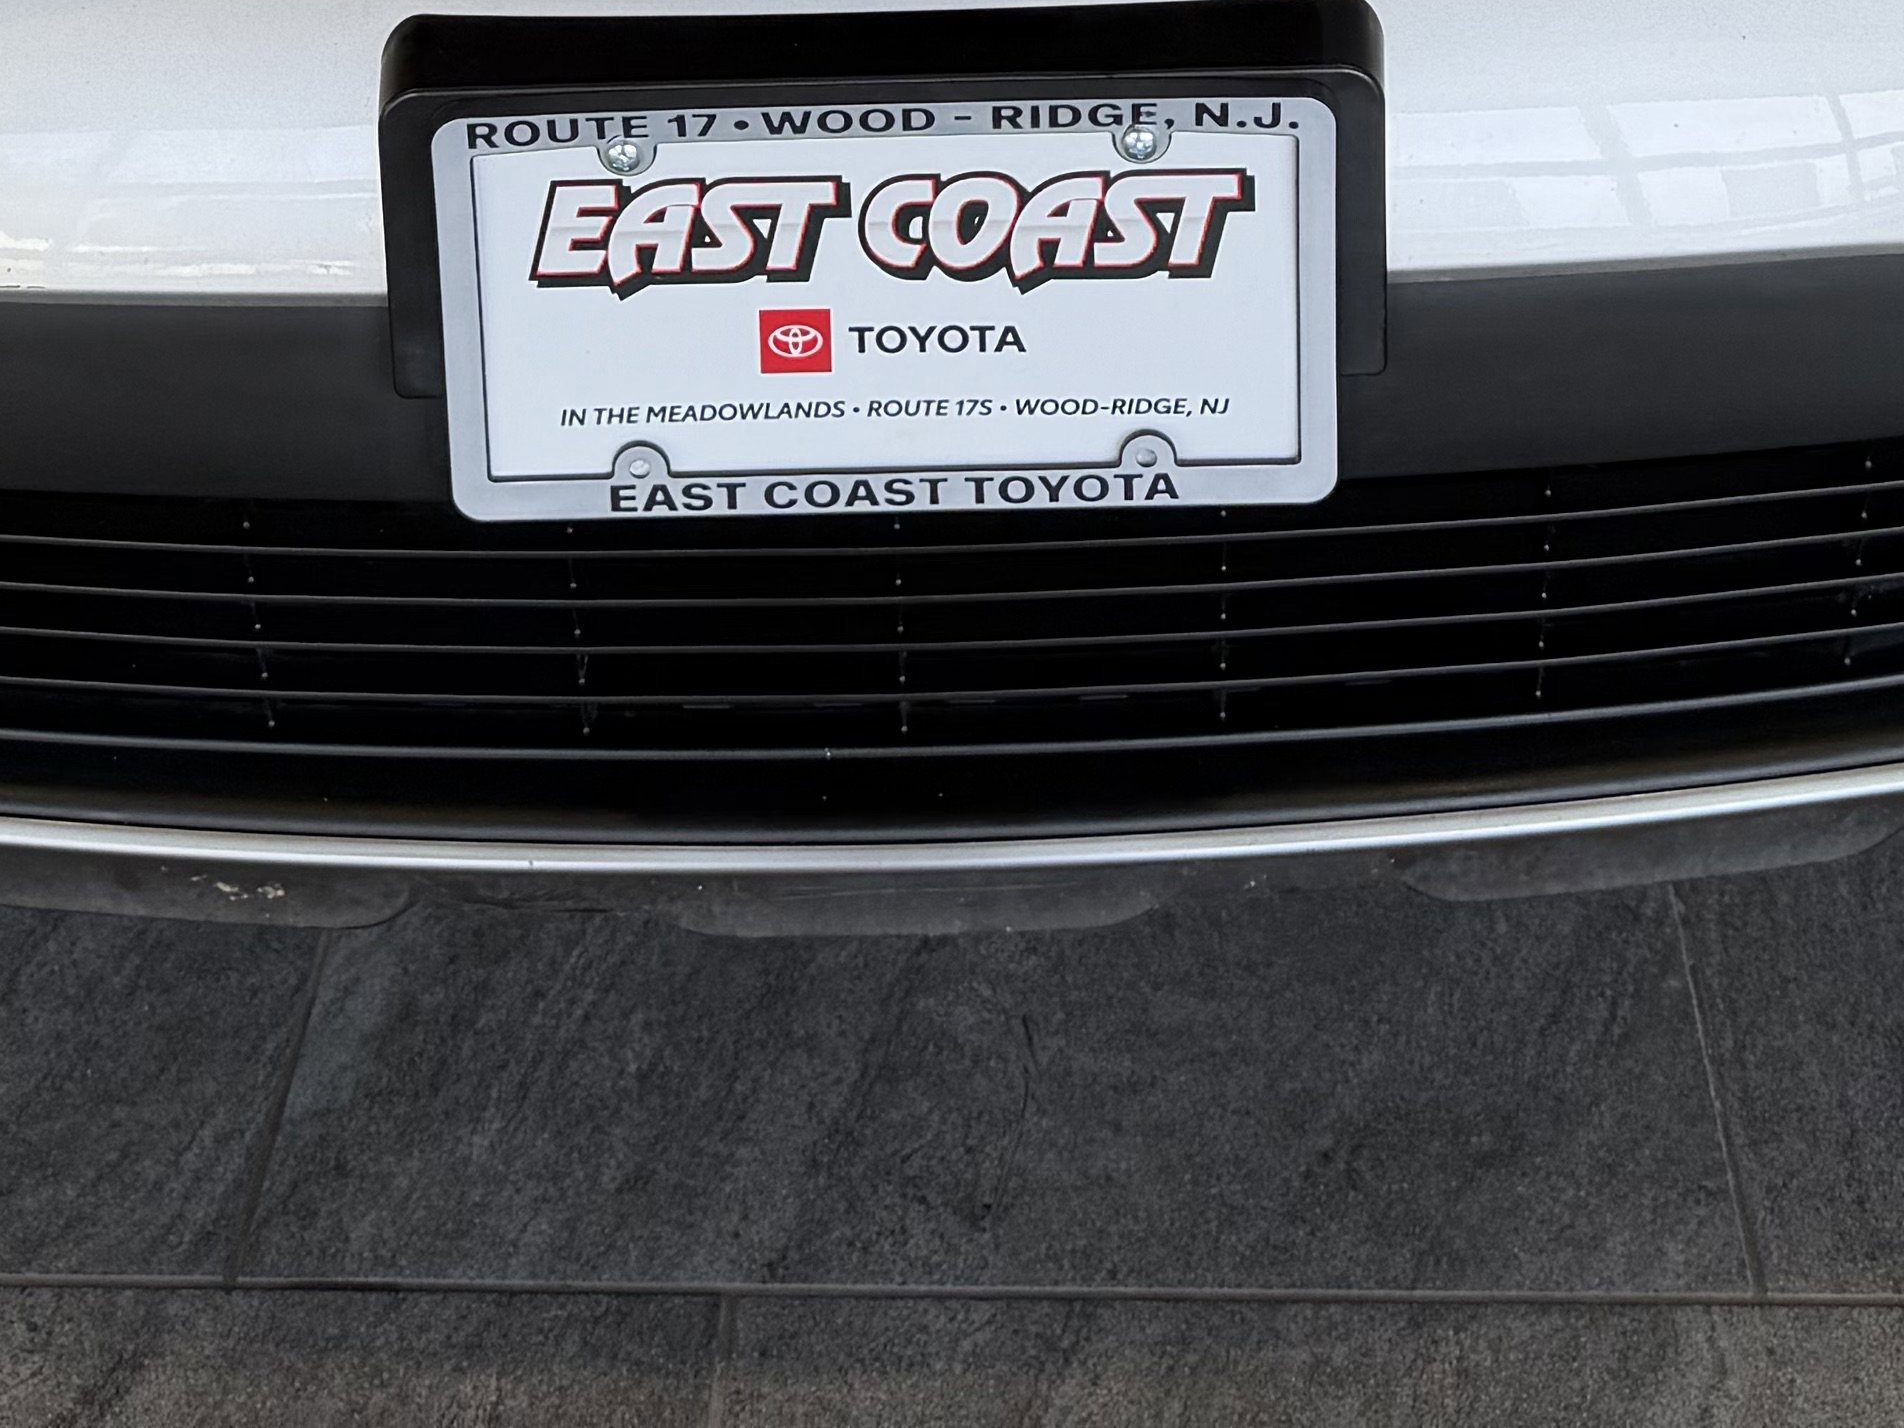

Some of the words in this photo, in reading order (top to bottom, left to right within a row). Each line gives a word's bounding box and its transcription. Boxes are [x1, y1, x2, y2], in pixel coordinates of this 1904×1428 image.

[466, 116, 649, 150] ROUTE
[667, 114, 718, 138] 17
[761, 107, 935, 134] WOOD
[992, 102, 1175, 130] RIDGE,
[1195, 101, 1300, 129] N.J.
[529, 175, 852, 301] EAST
[857, 167, 1256, 295] COAST
[848, 324, 1027, 354] TOYOTA
[560, 408, 587, 426] IN
[594, 406, 640, 425] THE
[646, 401, 846, 423] MEADOWLANDS
[867, 399, 949, 417] ROUTE
[955, 398, 993, 417] 17S
[1015, 397, 1192, 418] WOOD-RIDGE,
[1200, 397, 1231, 415] NJ
[609, 482, 747, 512] EAST
[764, 478, 948, 508] COAST
[964, 473, 1180, 505] TOYOTA
